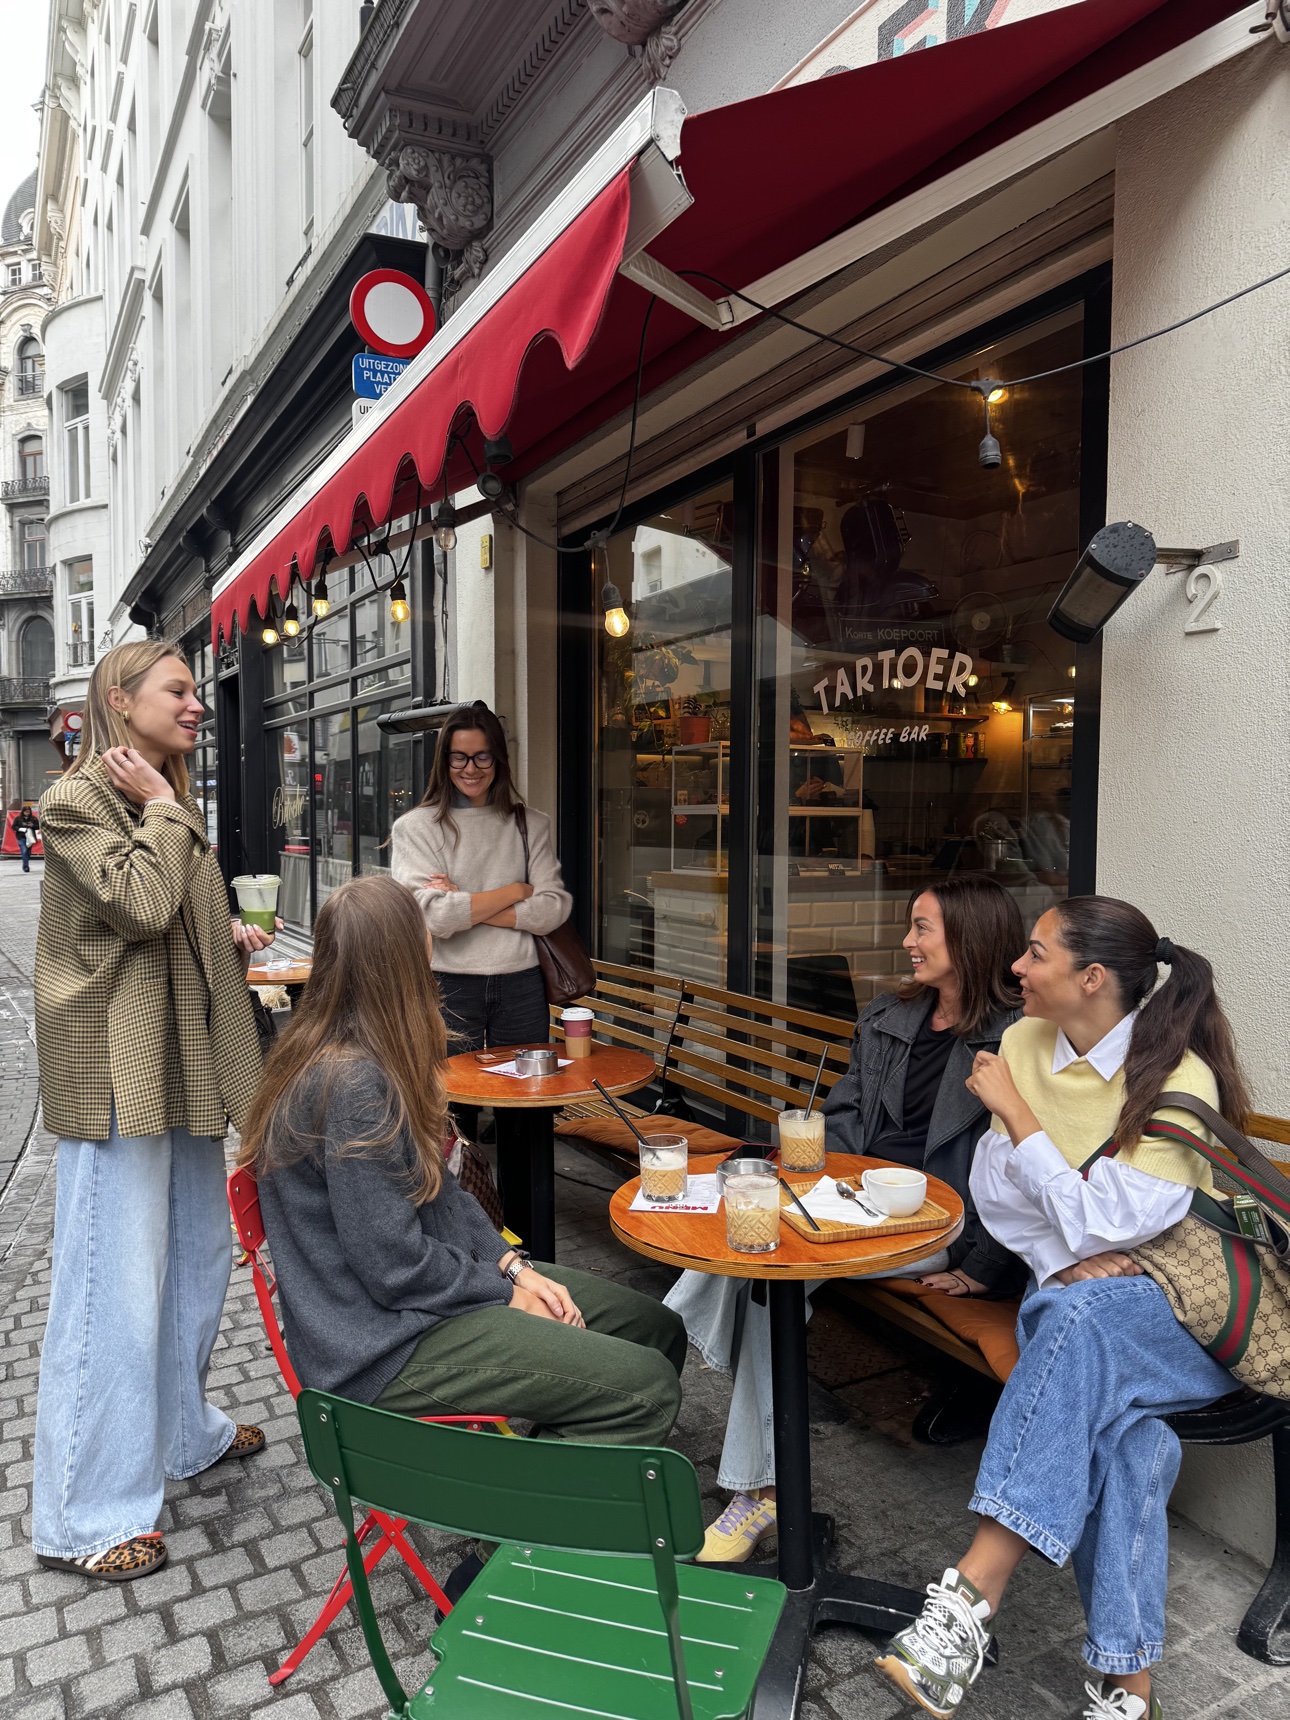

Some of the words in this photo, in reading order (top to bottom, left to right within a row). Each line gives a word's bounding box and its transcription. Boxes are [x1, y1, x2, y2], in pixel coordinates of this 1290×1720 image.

[359, 358, 409, 373] UITGEZON
[374, 384, 391, 395] VE
[359, 405, 373, 414] UI
[1184, 565, 1221, 635] 2
[877, 628, 938, 642] KOEPOORT
[813, 646, 973, 715] TARTOER
[848, 727, 895, 747] COFFEE
[901, 724, 930, 743] BAR
